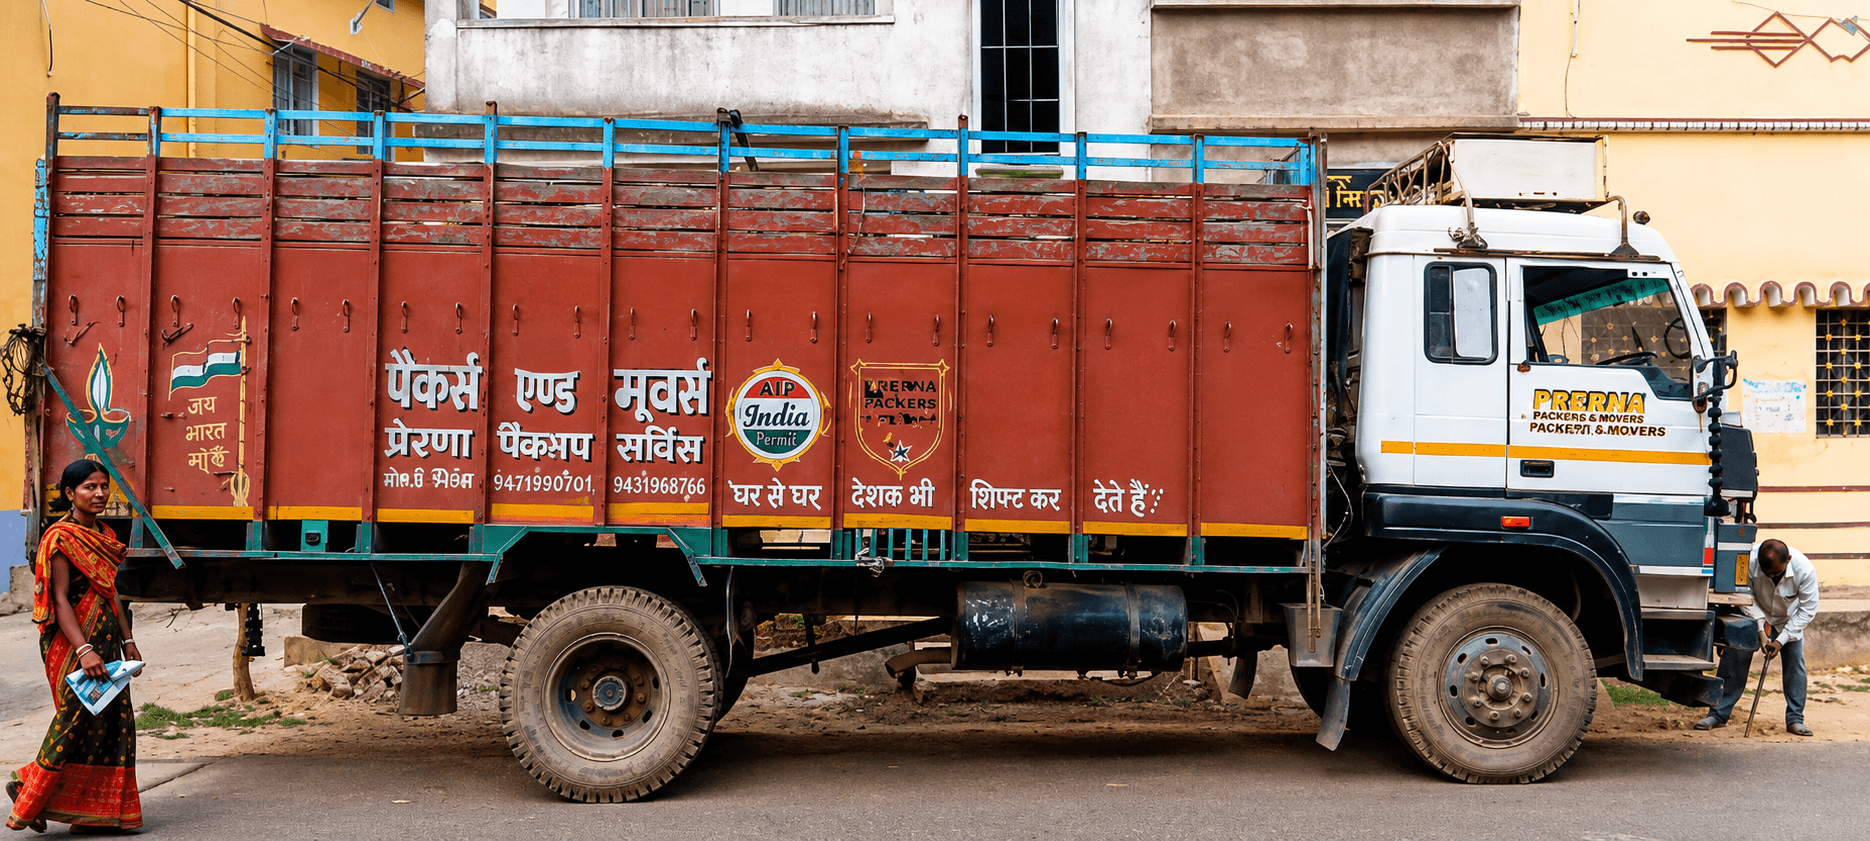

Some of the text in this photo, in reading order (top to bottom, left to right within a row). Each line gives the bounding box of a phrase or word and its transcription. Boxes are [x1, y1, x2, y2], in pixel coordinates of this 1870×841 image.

[385, 347, 712, 423] पैकर्स एण्ड मूवर्स
[188, 396, 217, 415] जय
[864, 397, 937, 409] PACKERS
[1533, 388, 1645, 414] PRERNA
[743, 402, 810, 427] India
[1599, 414, 1644, 424] MOVERS
[186, 422, 227, 441] भारत
[384, 417, 474, 460] प्रेरणा
[616, 425, 706, 464] सर्विस
[756, 431, 797, 446] Permit
[1607, 425, 1666, 437] MOVERS
[613, 475, 706, 495] 9431968766
[767, 477, 786, 508] से
[789, 485, 822, 511] घर
[909, 478, 935, 508] भी
[970, 478, 1026, 511] शिफ्ट
[1029, 489, 1062, 511] कर
[1093, 479, 1125, 513] देते
